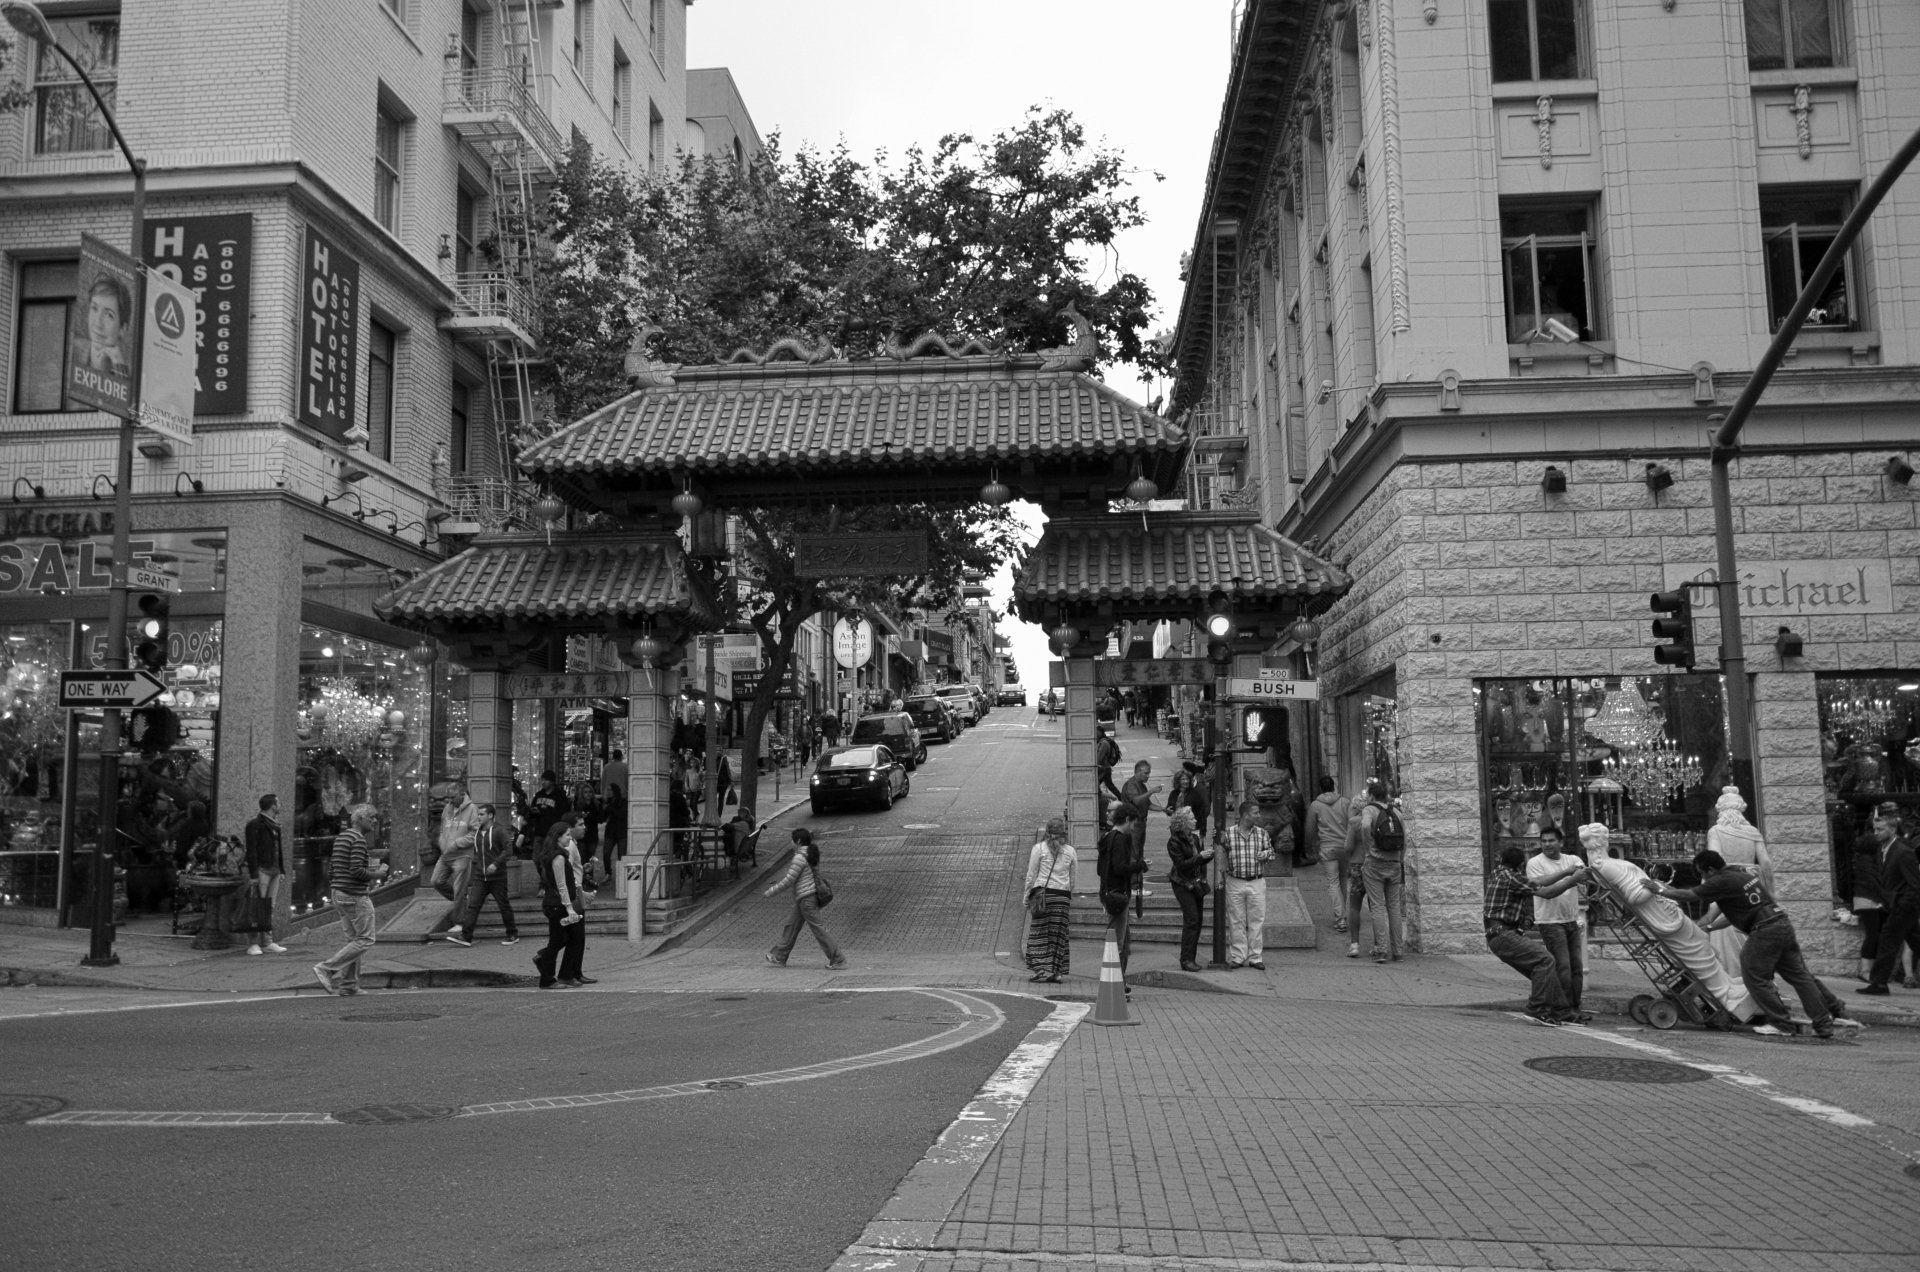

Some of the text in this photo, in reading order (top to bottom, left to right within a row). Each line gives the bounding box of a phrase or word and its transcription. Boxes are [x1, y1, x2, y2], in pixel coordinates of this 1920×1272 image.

[215, 240, 238, 391] (800) 6666696
[308, 239, 329, 418] HOTEL
[326, 272, 339, 415] ASTORIA
[74, 366, 128, 401] EXPLORE
[136, 572, 171, 588] GRANT
[715, 671, 728, 689] IFTS
[1270, 670, 1287, 678] 500
[68, 683, 130, 696] ONE WAY
[1253, 682, 1295, 695] BUSH
[560, 698, 586, 708] ATM
